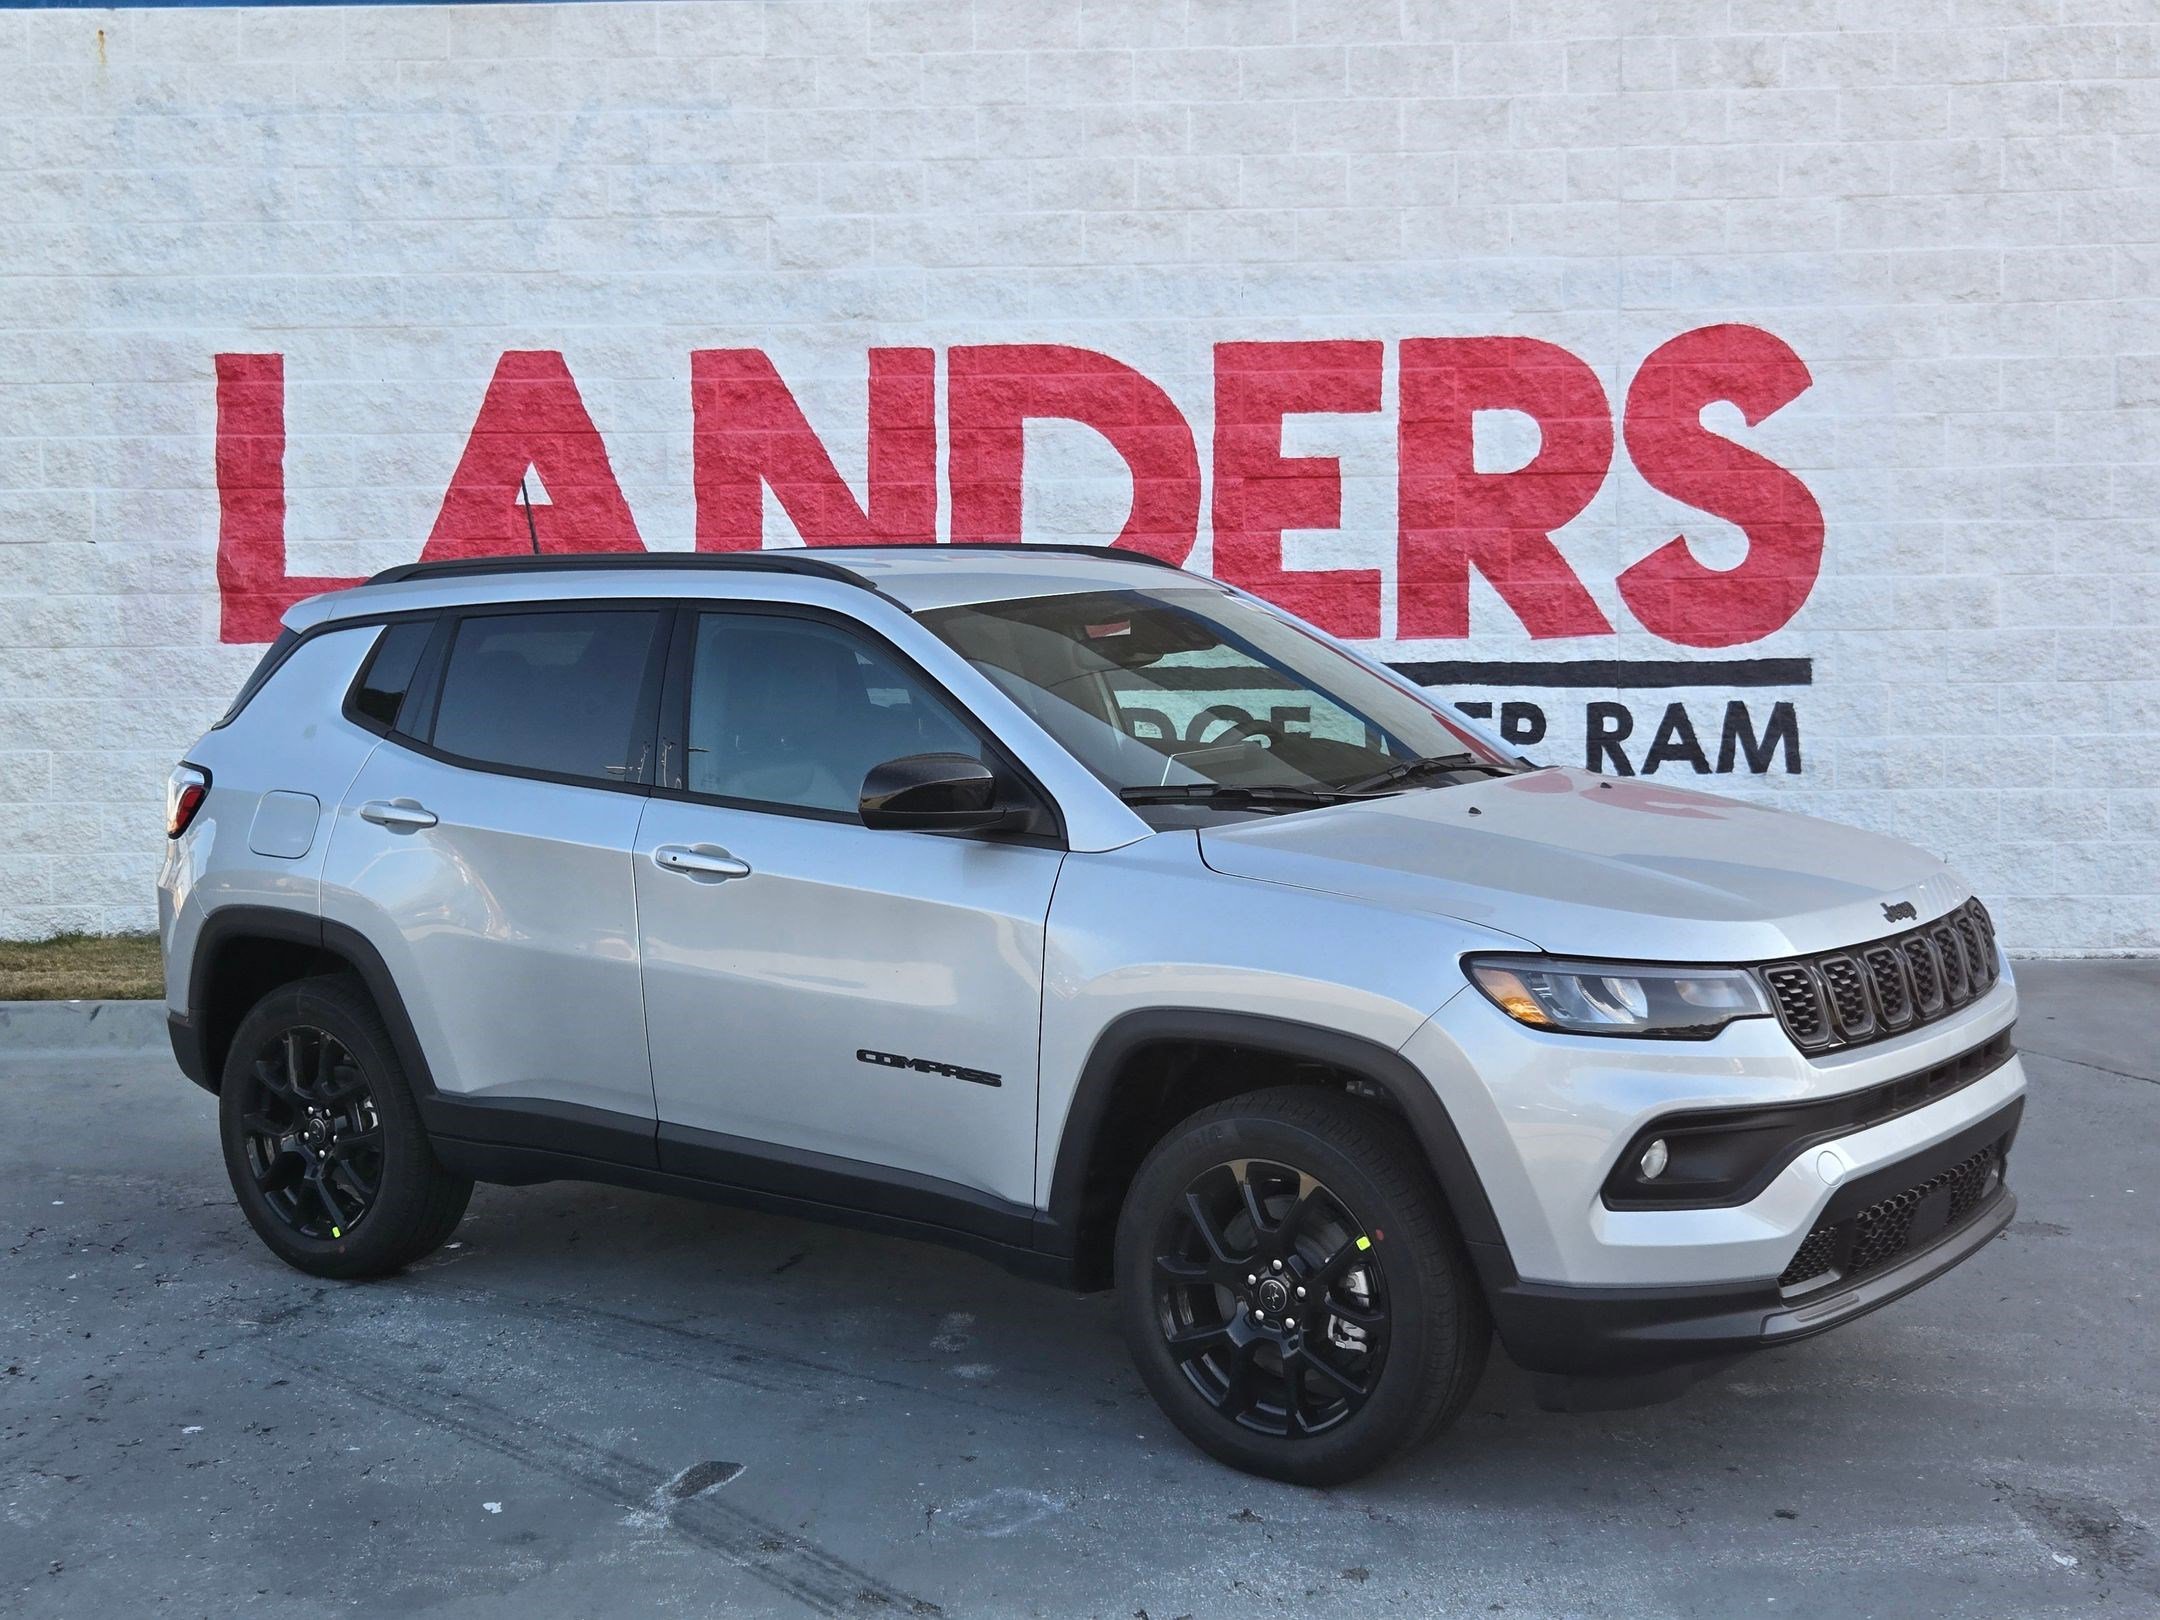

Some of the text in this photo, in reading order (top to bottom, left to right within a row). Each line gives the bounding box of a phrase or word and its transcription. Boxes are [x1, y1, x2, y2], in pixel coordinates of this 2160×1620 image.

[215, 324, 1825, 648] LANDERS
[1586, 700, 1802, 776] RAM
[1880, 901, 1917, 923] Jeep
[856, 1049, 1002, 1088] COMPASS
